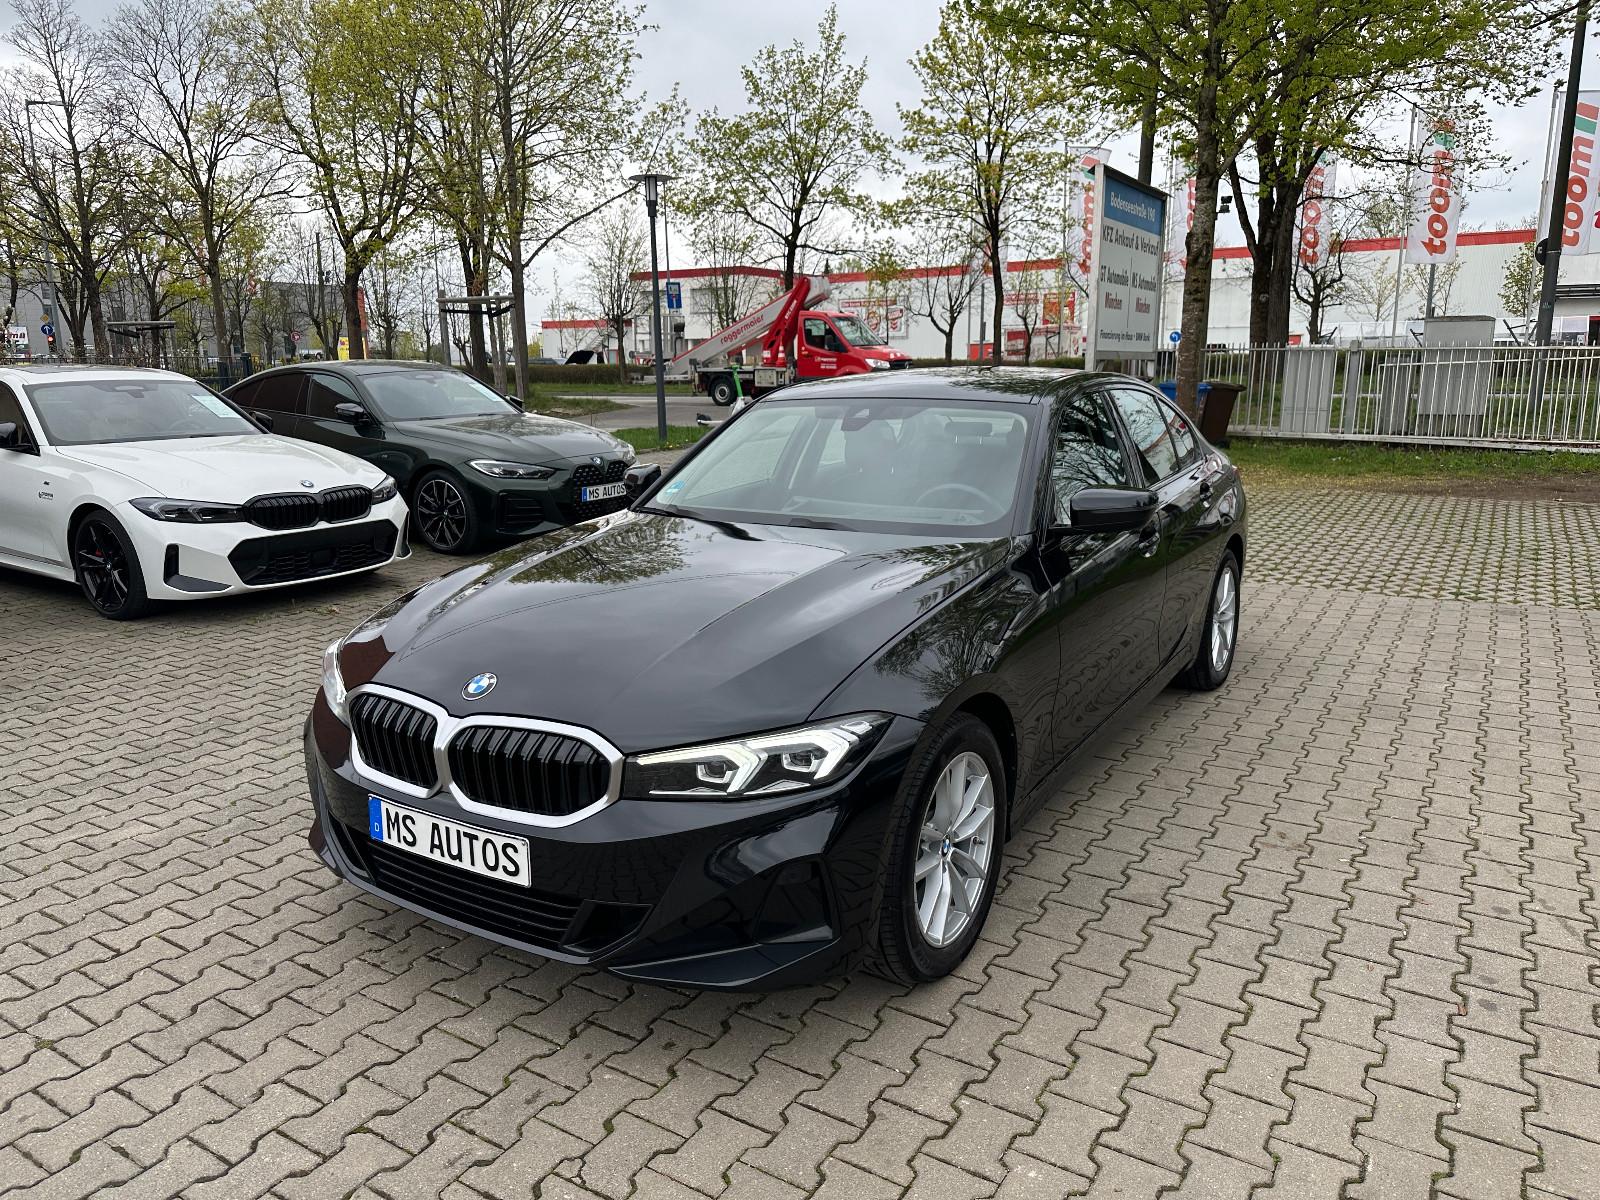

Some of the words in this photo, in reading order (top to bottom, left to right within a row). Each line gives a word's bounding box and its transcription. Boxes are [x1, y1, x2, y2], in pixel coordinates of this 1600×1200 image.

[1299, 166, 1325, 265] toom
[1420, 150, 1454, 256] toom
[1103, 224, 1113, 243] KFZ
[1115, 227, 1134, 249] Ankauf
[1135, 234, 1140, 251] &
[1141, 236, 1159, 256] Verkauf
[1107, 266, 1129, 287] Automobile
[1105, 291, 1122, 310] München
[589, 487, 600, 499] MS
[603, 483, 625, 497] AUTOS
[374, 822, 380, 832] D
[385, 807, 417, 848] MS
[430, 821, 521, 878] AUTOS
